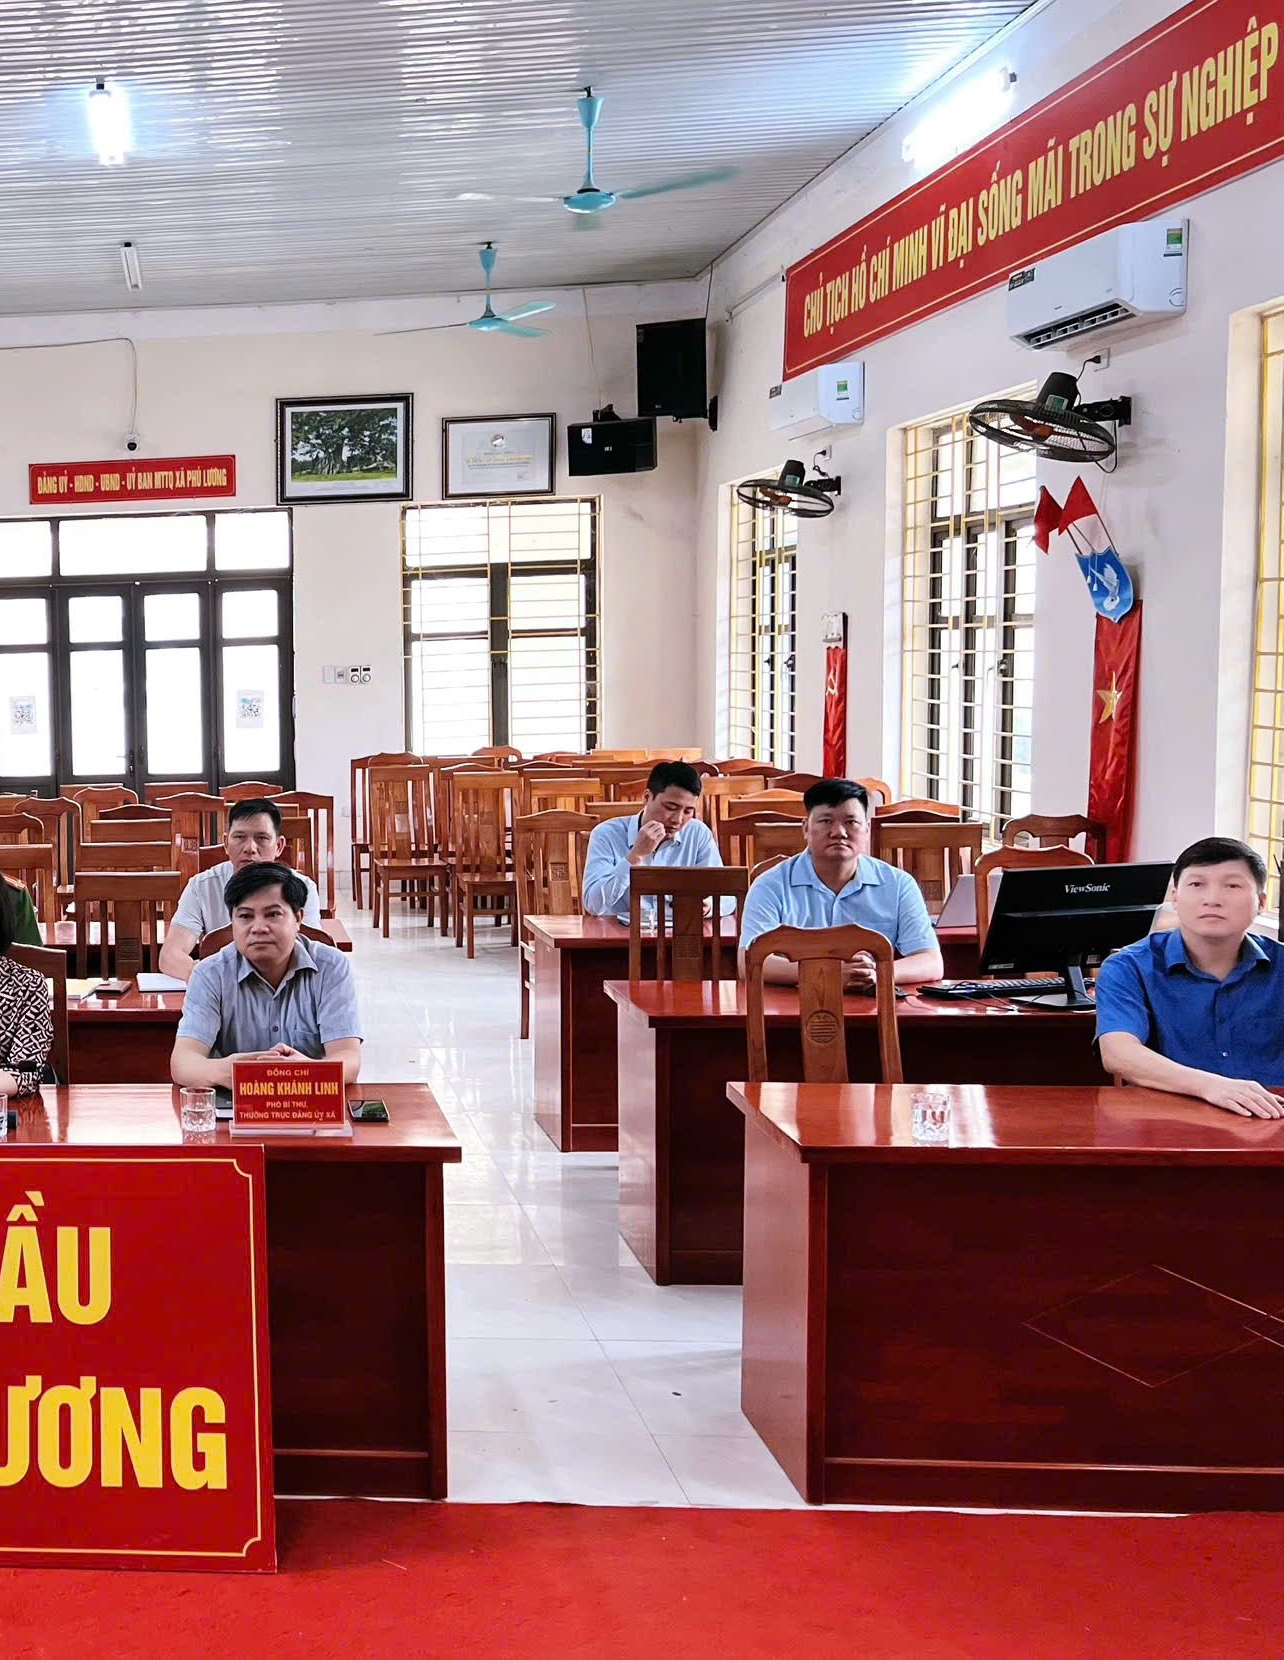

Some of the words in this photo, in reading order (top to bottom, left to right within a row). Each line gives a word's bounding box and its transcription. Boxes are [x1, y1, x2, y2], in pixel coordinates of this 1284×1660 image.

[803, 271, 824, 338] CHỦ
[826, 271, 849, 335] TỊCH
[851, 244, 867, 314] HỒ
[869, 236, 891, 303] CHÍ
[892, 224, 928, 292] MINH
[931, 203, 946, 271] VĨ
[947, 197, 974, 268] ĐẠI
[977, 160, 1023, 246] SỐNG
[1027, 136, 1064, 221] MÃI
[1069, 103, 1136, 199] TRONG
[1143, 70, 1178, 168] SỰ
[1181, 15, 1279, 142] NGHIỆP
[37, 470, 57, 494] ĐẢNG
[137, 471, 153, 489] BAN
[154, 471, 174, 490] MTTQ
[175, 467, 186, 488] XÃ
[186, 465, 202, 488] PHÚ
[203, 466, 227, 487] LƯƠNG
[1064, 882, 1111, 894] ViewSonic
[267, 1067, 291, 1076] ĐỒNG
[294, 1068, 309, 1076] CHÍ
[239, 1080, 275, 1096] HOÀNG
[277, 1079, 312, 1095] KHÁNH
[314, 1082, 339, 1095] LINH
[239, 1110, 269, 1119] THƯỜNG
[292, 1110, 312, 1118] ĐẢNG
